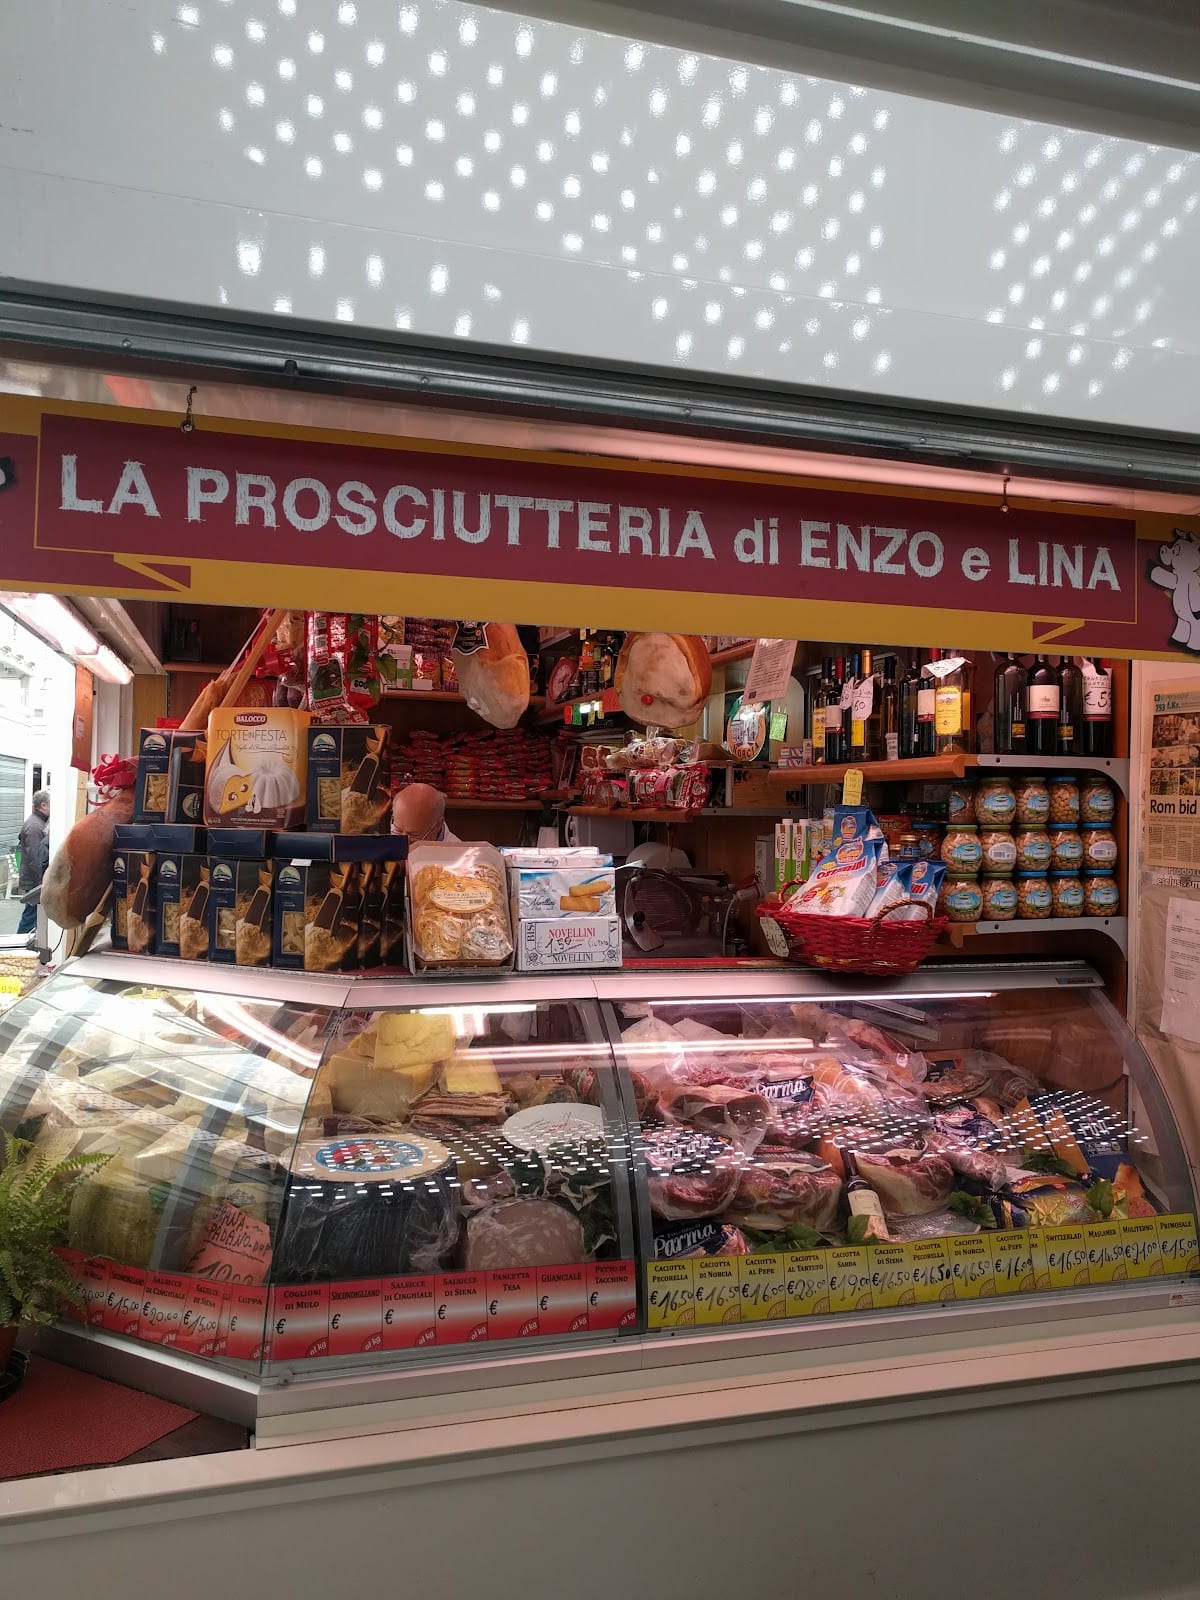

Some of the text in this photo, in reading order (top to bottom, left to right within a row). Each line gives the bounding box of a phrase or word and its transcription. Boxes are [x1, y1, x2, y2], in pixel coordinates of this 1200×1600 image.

[59, 453, 1122, 592] LA PROSCIUTTERIA di ENZO e LINA
[235, 715, 266, 723] BALOCCO
[1150, 798, 1197, 815] Rom bid
[549, 927, 596, 938] NOVELLINI
[552, 953, 593, 962] NOVELLINI
[654, 1224, 717, 1259] Parma
[954, 1238, 984, 1247] CACIOTTA
[996, 1234, 1024, 1243] CACIOTTA
[874, 1247, 904, 1256] CACIOTTA
[914, 1242, 942, 1251] CACIOTTA
[962, 1248, 985, 1256] NORCIA
[1124, 1245, 1131, 1258] €
[1161, 1240, 1168, 1254] €
[790, 1254, 819, 1263] CACIOTTA
[832, 1250, 861, 1259] CACIOTTA
[885, 1256, 903, 1264] SIENA
[913, 1252, 945, 1261] PECORELLA
[1048, 1253, 1055, 1267] €
[1088, 1249, 1096, 1263] €
[654, 1264, 686, 1272] CACIOTTA
[699, 1261, 731, 1269] CACIOTTA
[745, 1258, 777, 1266] CACIOTTA
[787, 1263, 824, 1273] AL TARTUFO
[837, 1260, 857, 1268] SARDA
[994, 1259, 1002, 1273] €
[493, 1272, 530, 1280] PANCETTA
[541, 1271, 582, 1283] GUANCIALE
[707, 1270, 733, 1278] NORCIA
[748, 1267, 775, 1276] AL PEPE
[912, 1268, 920, 1282] €
[953, 1263, 960, 1277] €
[390, 1280, 426, 1290] SALSICCE
[443, 1276, 477, 1286] SALSICCE
[652, 1274, 689, 1283] PECORELLA
[829, 1276, 837, 1290] €
[871, 1272, 880, 1287] €
[283, 1288, 321, 1299] COGLIONI
[444, 1288, 477, 1297] DI SIENA
[503, 1283, 521, 1292] TESA
[695, 1286, 704, 1301] €
[741, 1283, 750, 1298] €
[786, 1280, 795, 1295] €
[107, 1292, 116, 1306] €
[384, 1290, 433, 1302] DI CINGHIALE
[539, 1295, 549, 1311] €
[589, 1291, 599, 1307] €
[650, 1290, 659, 1305] €
[142, 1301, 151, 1317] €
[285, 1300, 320, 1311] DI MULO
[437, 1304, 447, 1320] €
[488, 1300, 498, 1316] €
[183, 1309, 192, 1325] €
[230, 1315, 238, 1332] €
[331, 1313, 341, 1330] €
[384, 1309, 394, 1325] €
[571, 1316, 588, 1331] al kg
[275, 1317, 286, 1335] €
[470, 1325, 487, 1341] al kg
[521, 1321, 538, 1337] al kg
[364, 1335, 382, 1352] al kg
[418, 1330, 435, 1346] al kg
[309, 1340, 327, 1356] al kg
